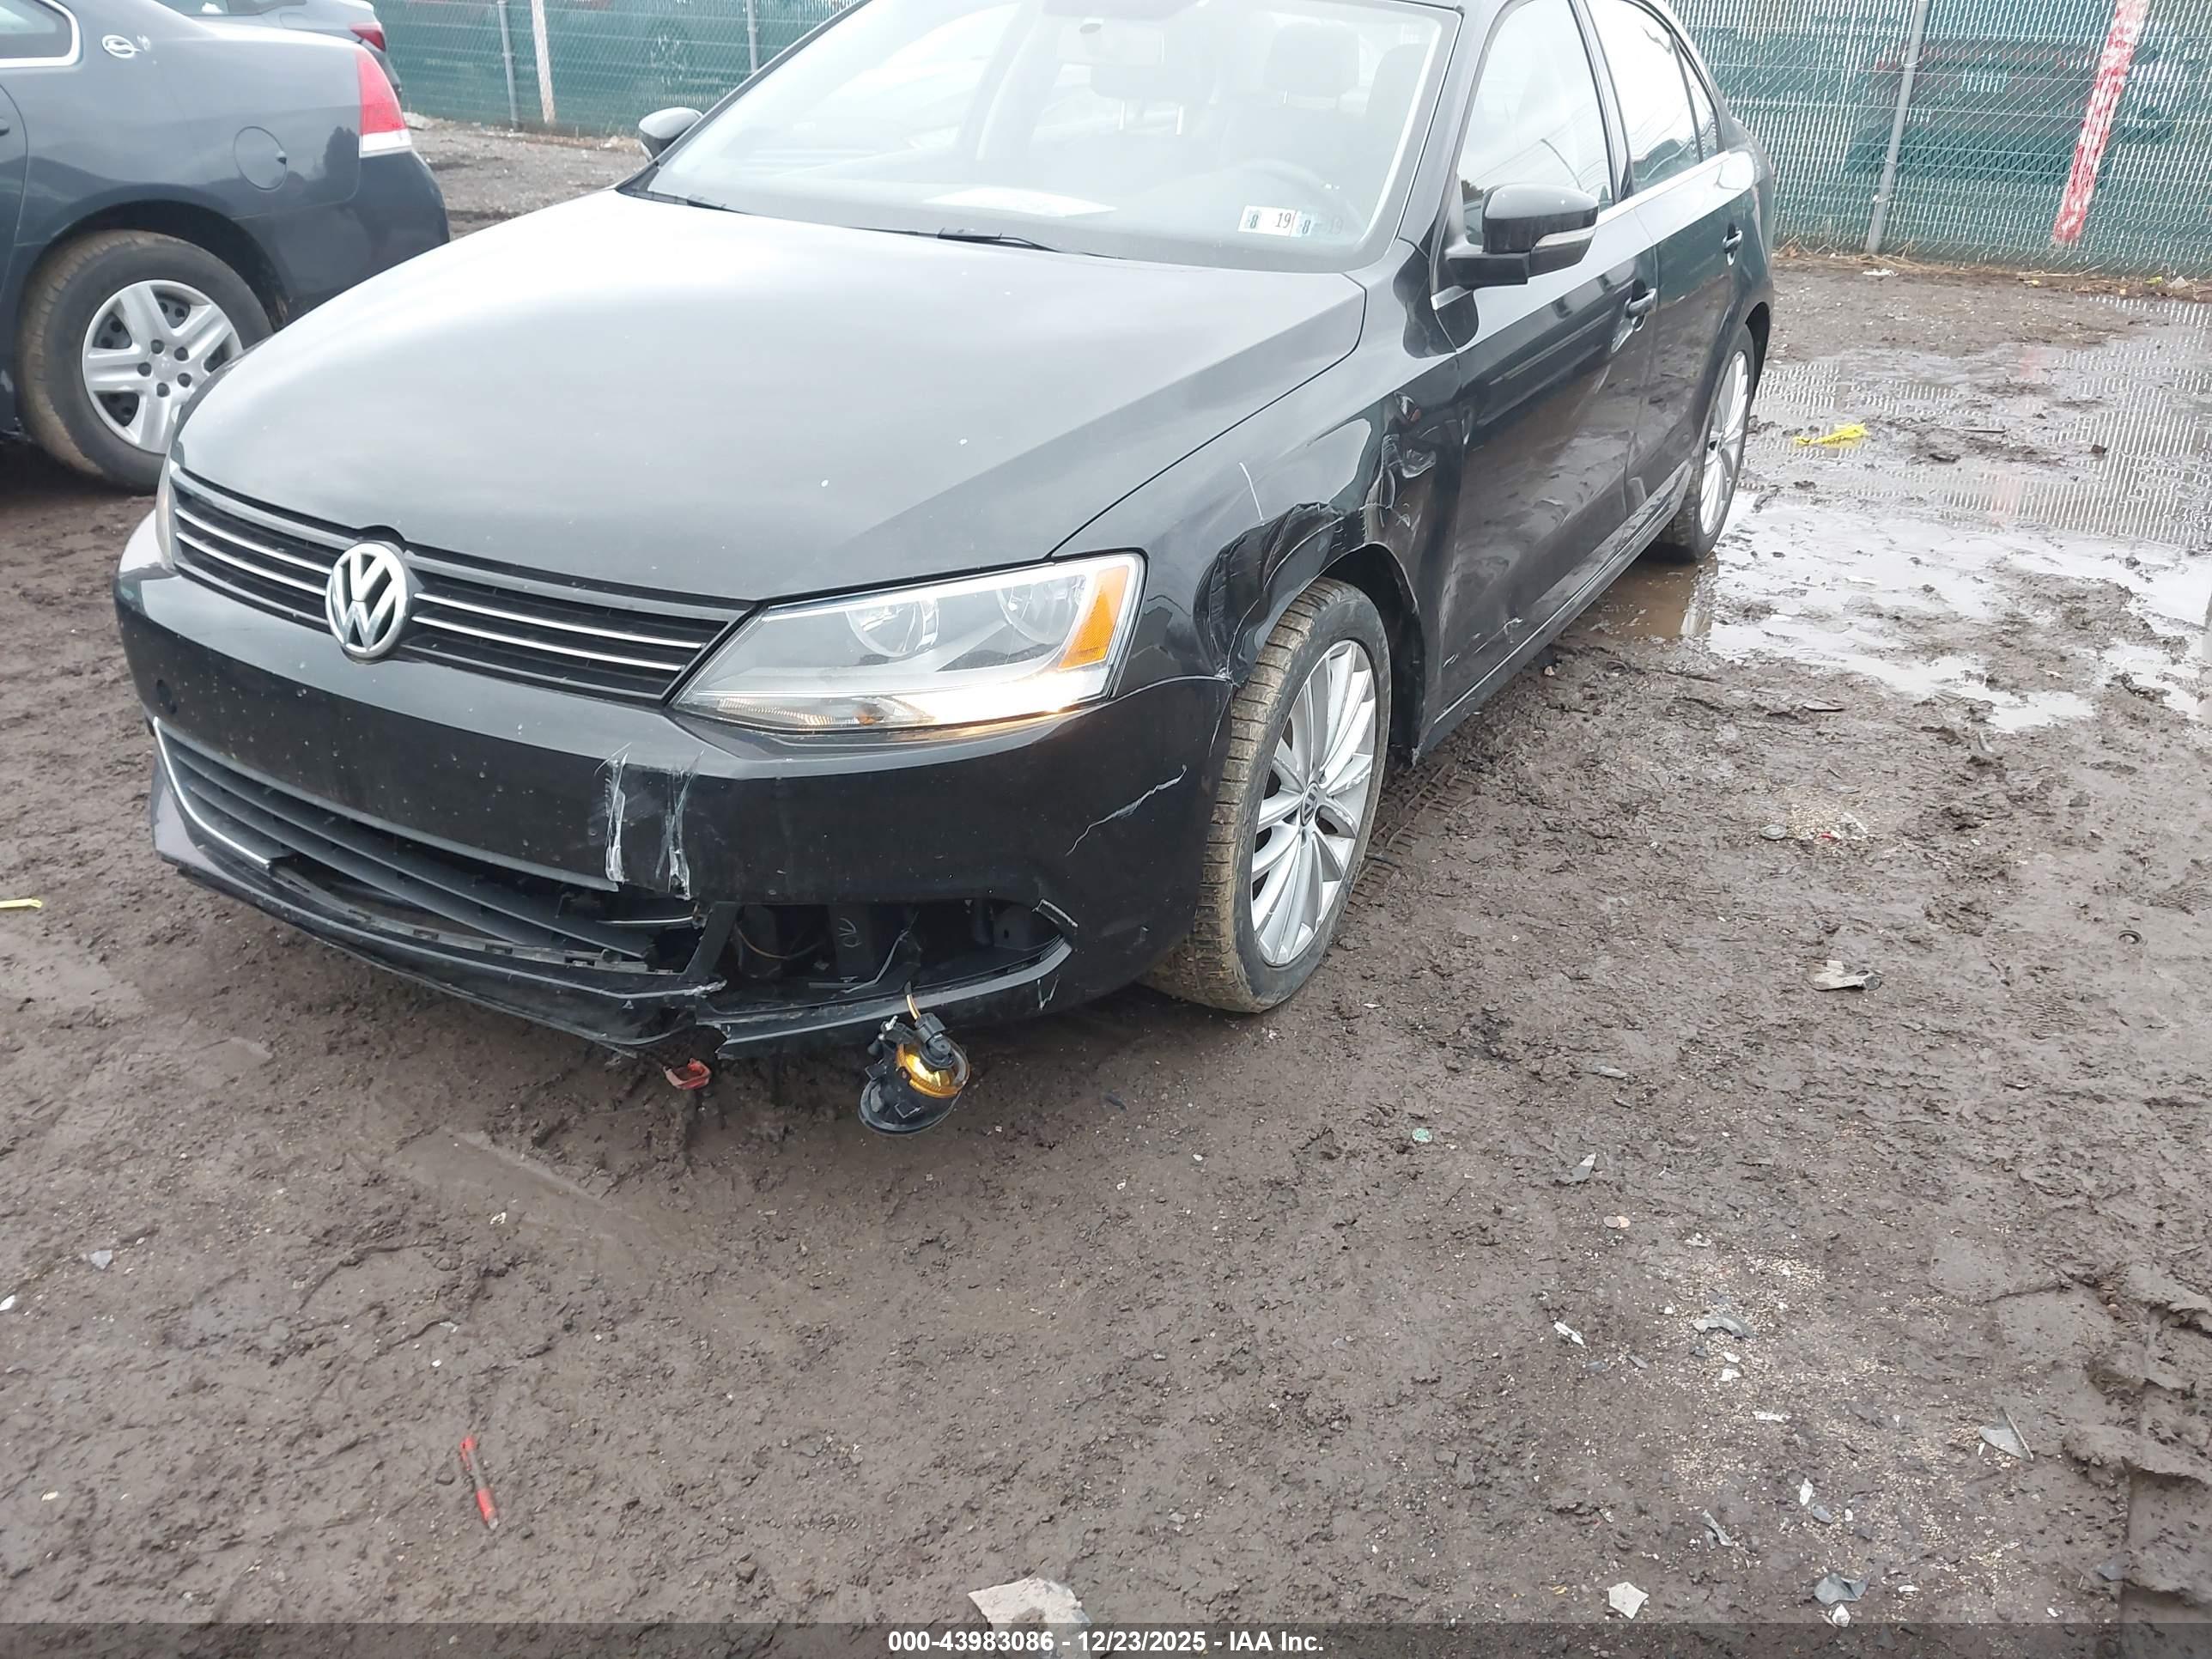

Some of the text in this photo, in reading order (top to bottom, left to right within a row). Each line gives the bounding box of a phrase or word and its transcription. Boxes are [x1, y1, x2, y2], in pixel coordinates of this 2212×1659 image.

[1249, 212, 1291, 229] 8 19
[1302, 219, 1311, 234] 8
[327, 544, 405, 656] VW
